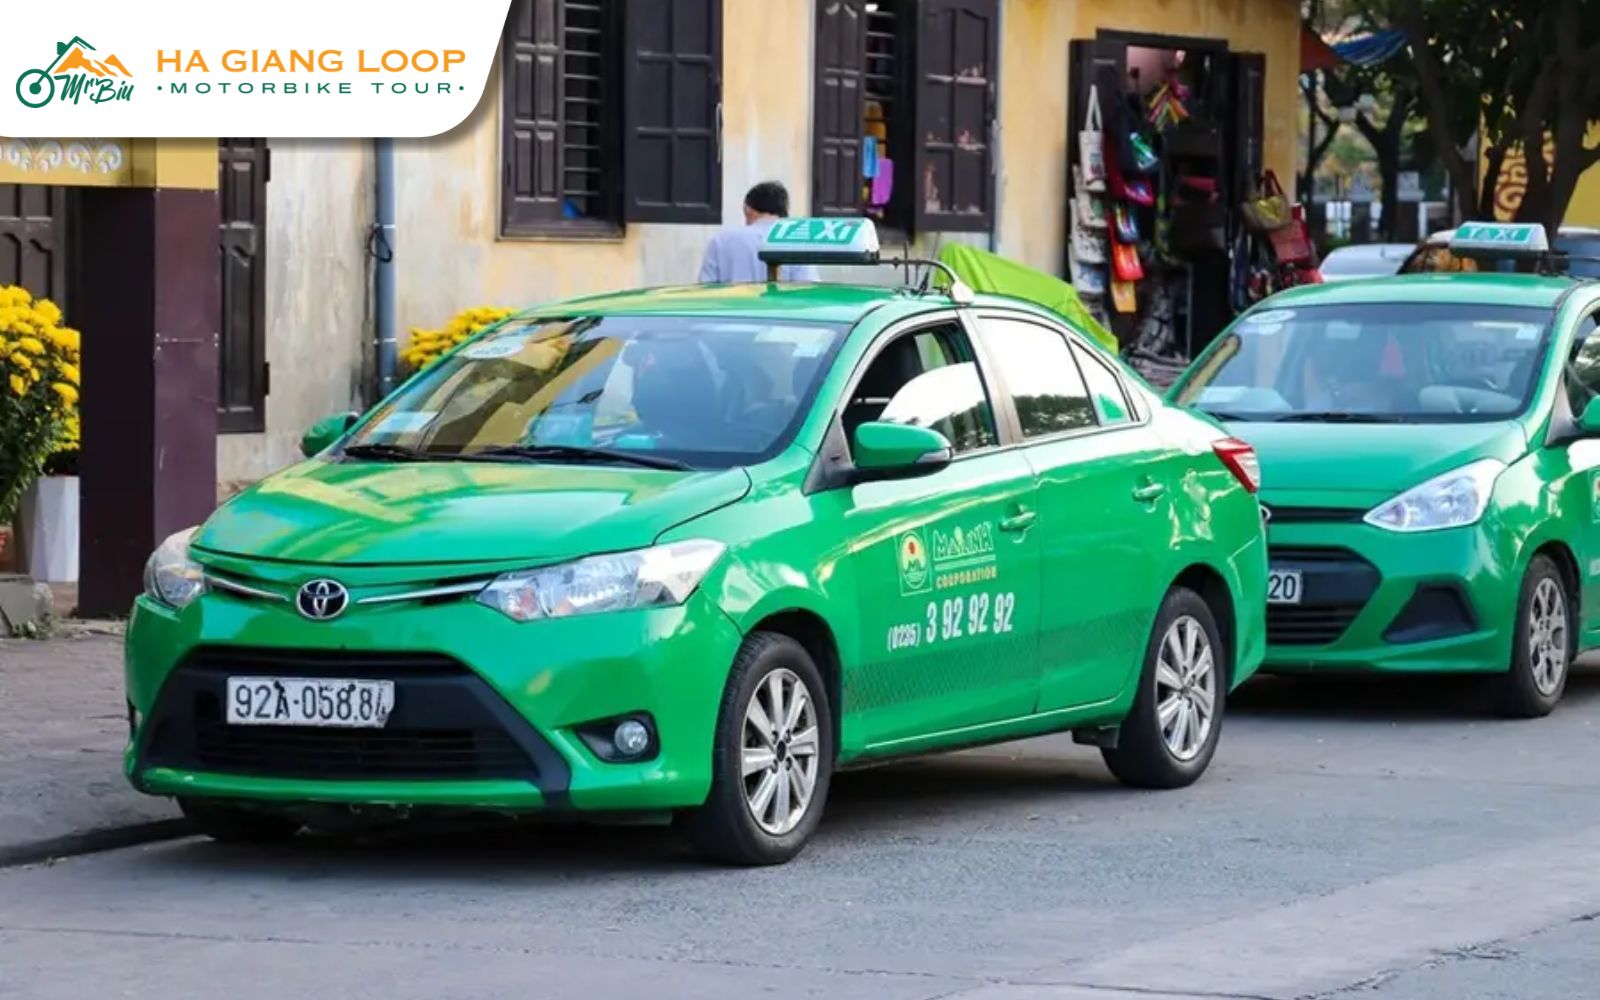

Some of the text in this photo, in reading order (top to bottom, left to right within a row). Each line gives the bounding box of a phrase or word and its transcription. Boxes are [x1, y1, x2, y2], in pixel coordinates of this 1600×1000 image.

[774, 218, 853, 241] TAXI
[1468, 227, 1518, 242] TAXI
[925, 602, 938, 643] 3
[942, 597, 964, 640] 92
[968, 592, 989, 635] 92
[993, 592, 1014, 634] 92
